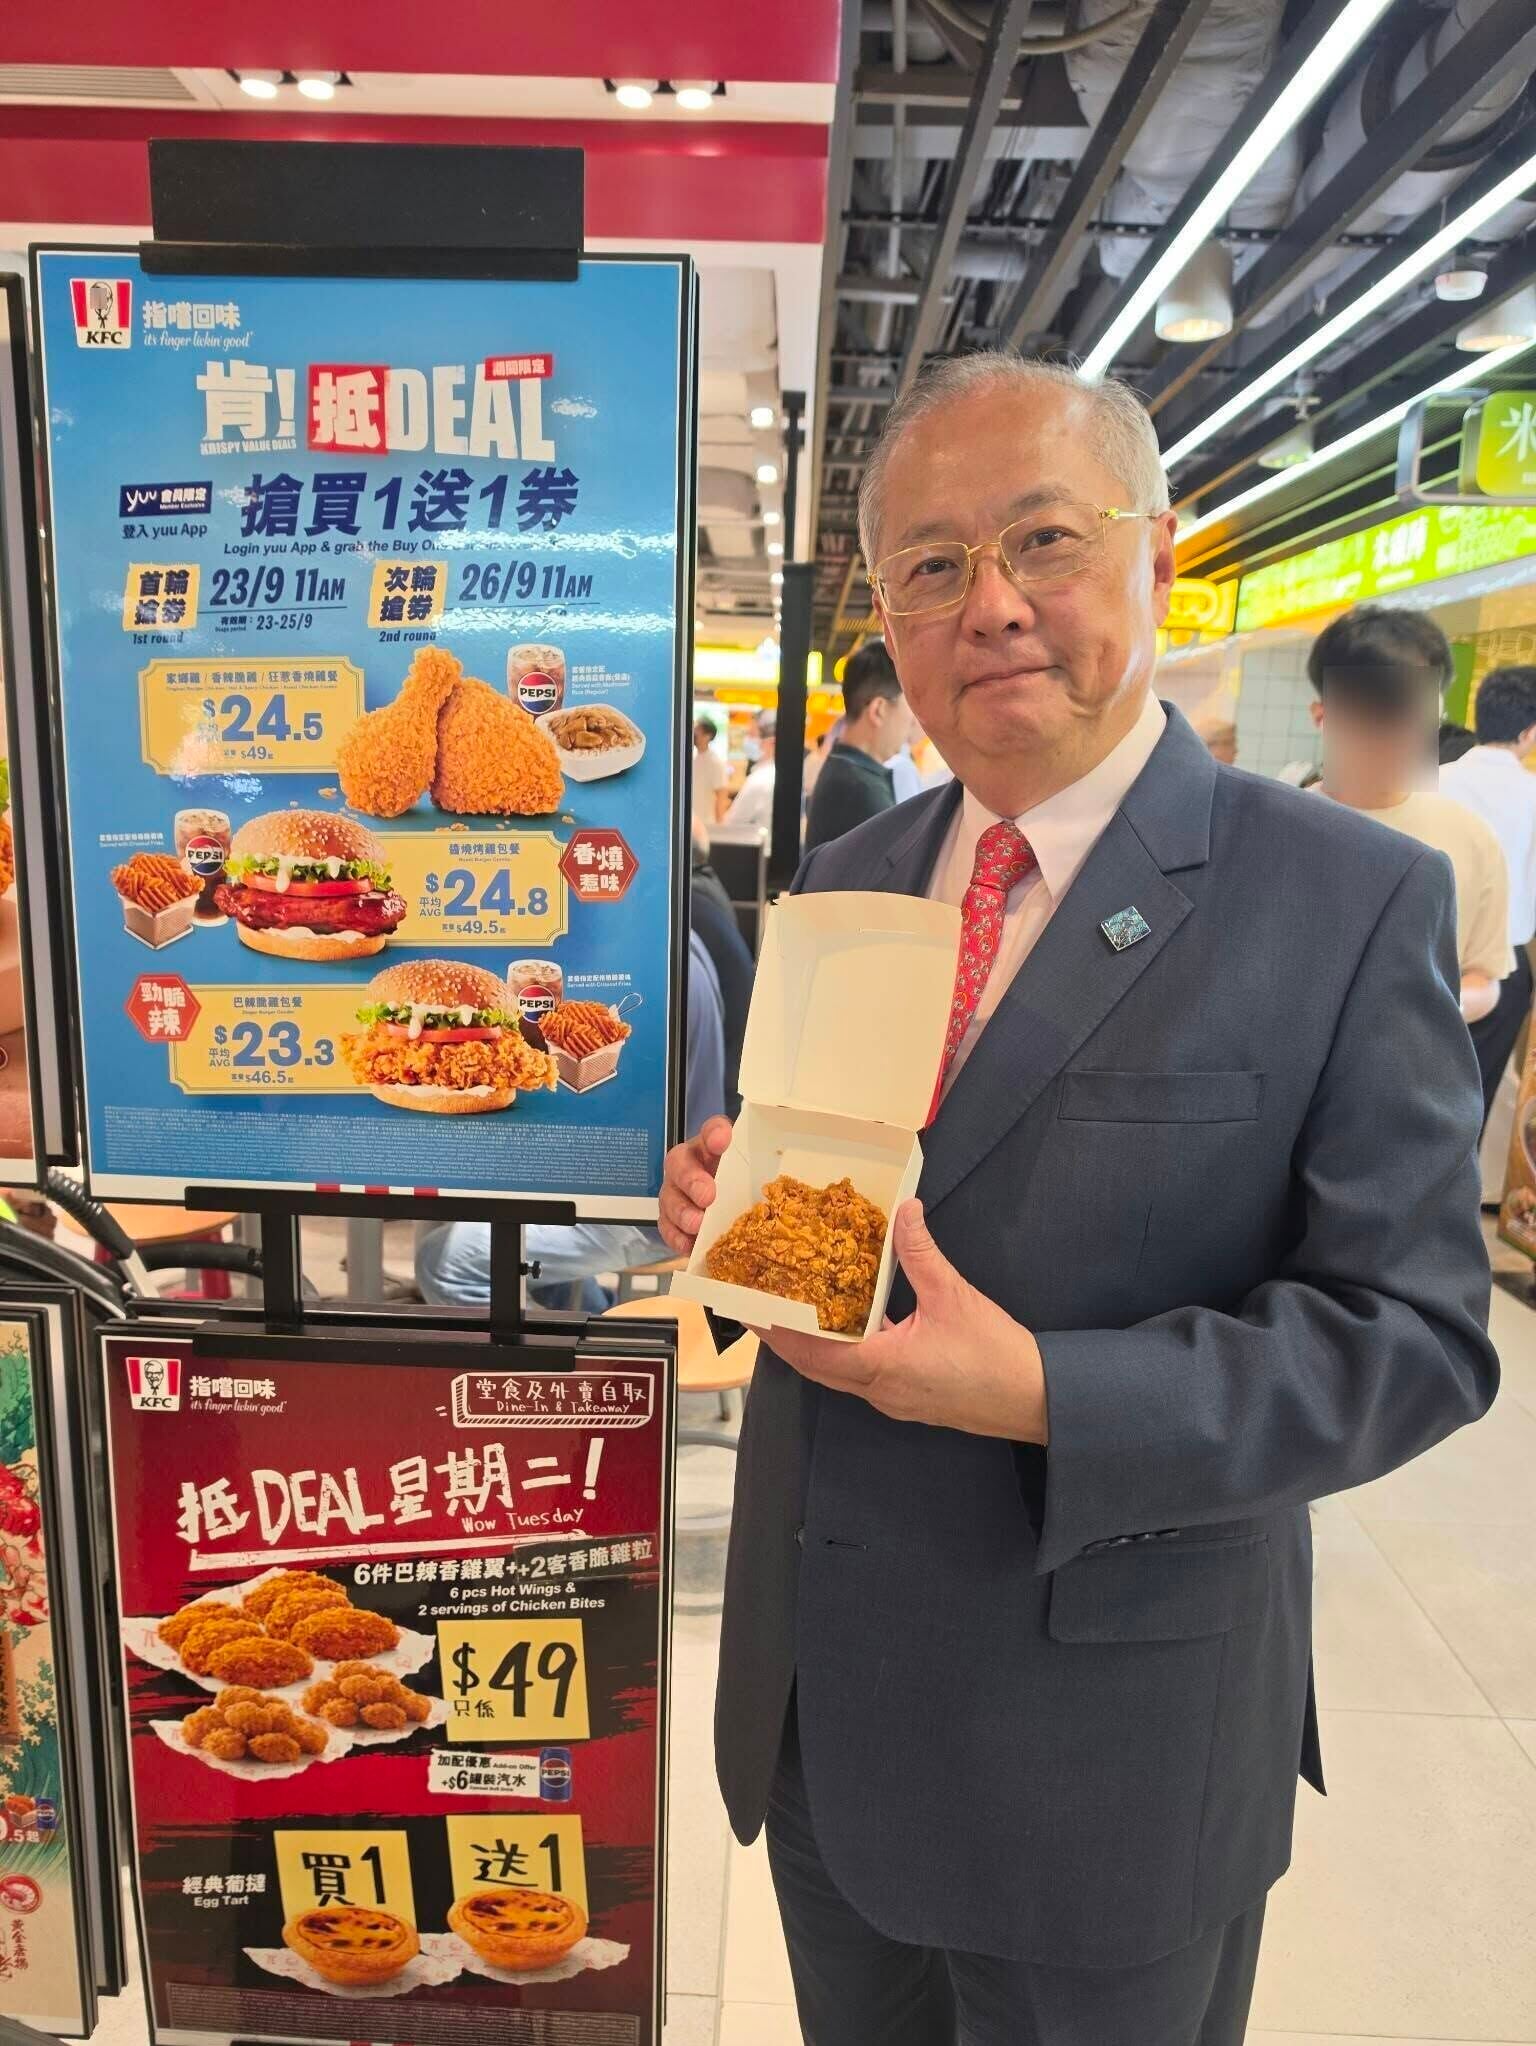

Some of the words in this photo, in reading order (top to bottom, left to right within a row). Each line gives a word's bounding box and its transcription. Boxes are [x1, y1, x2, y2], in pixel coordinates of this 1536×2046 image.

[142, 300, 241, 330] 指嚐回味
[86, 331, 123, 345] KFC
[160, 331, 191, 351] finger
[200, 441, 240, 456] KRISPY
[242, 440, 271, 453] VALUE
[272, 438, 296, 451] DEALS
[126, 489, 157, 512] yuu
[161, 487, 207, 503] 會員限定
[160, 502, 179, 510] Member
[180, 501, 205, 509] Exclusive
[122, 524, 148, 539] 登入
[152, 526, 178, 539] yuu
[180, 522, 207, 538] App
[224, 543, 259, 556] Login
[264, 543, 287, 555] yuu
[291, 541, 317, 555] App
[320, 541, 330, 552] &
[334, 541, 363, 554] grab
[368, 540, 388, 551] the
[393, 539, 418, 553] Buy
[139, 569, 190, 596] 首輪
[209, 565, 285, 608] 23/9
[295, 567, 346, 602] 11AM
[384, 565, 438, 592] 次輪
[459, 560, 537, 603] 26/9
[541, 565, 593, 598] 11AM
[380, 595, 433, 621] 搶券
[256, 613, 313, 631] 23-25/9
[133, 633, 147, 645] 1st
[151, 632, 183, 644] round
[379, 631, 400, 642] 2nd
[520, 687, 555, 698] PEPSI
[203, 694, 323, 742] $24.5
[188, 849, 223, 861] PEPSI
[426, 868, 548, 917] $24.8
[419, 896, 441, 908] 平均
[419, 908, 441, 917] AVG
[520, 998, 554, 1009] PEPSI
[209, 1048, 230, 1058] 平均
[214, 1021, 334, 1067] $23.3
[209, 1059, 230, 1067] AVG
[189, 1375, 276, 1399] 指嚐回味
[476, 1377, 647, 1403] 堂食及外賣自取
[140, 1397, 173, 1408] KFC
[204, 1398, 232, 1415] finger
[496, 1400, 549, 1413] Dine-In
[555, 1400, 562, 1412] &
[570, 1401, 630, 1414] Takeaway
[462, 1515, 496, 1534] Wow
[506, 1507, 584, 1531] Tuesday
[450, 1587, 459, 1598] 6
[461, 1588, 486, 1600] pcs
[491, 1585, 515, 1597] Hot
[519, 1583, 561, 1597] Wings
[565, 1582, 576, 1593] &
[418, 1604, 427, 1616] 2
[430, 1602, 488, 1616] servings
[492, 1600, 506, 1612] of
[509, 1598, 566, 1612] Chicken
[570, 1597, 605, 1610] Bites
[452, 1642, 577, 1718] $49
[454, 1699, 495, 1718] 只係
[438, 1754, 492, 1768] 加配優惠
[470, 1833, 563, 1892] 送1
[182, 1873, 266, 1895] 經典葡撻
[301, 1846, 386, 1907] 買1
[194, 1897, 220, 1908] Egg
[223, 1894, 248, 1906] Tart
